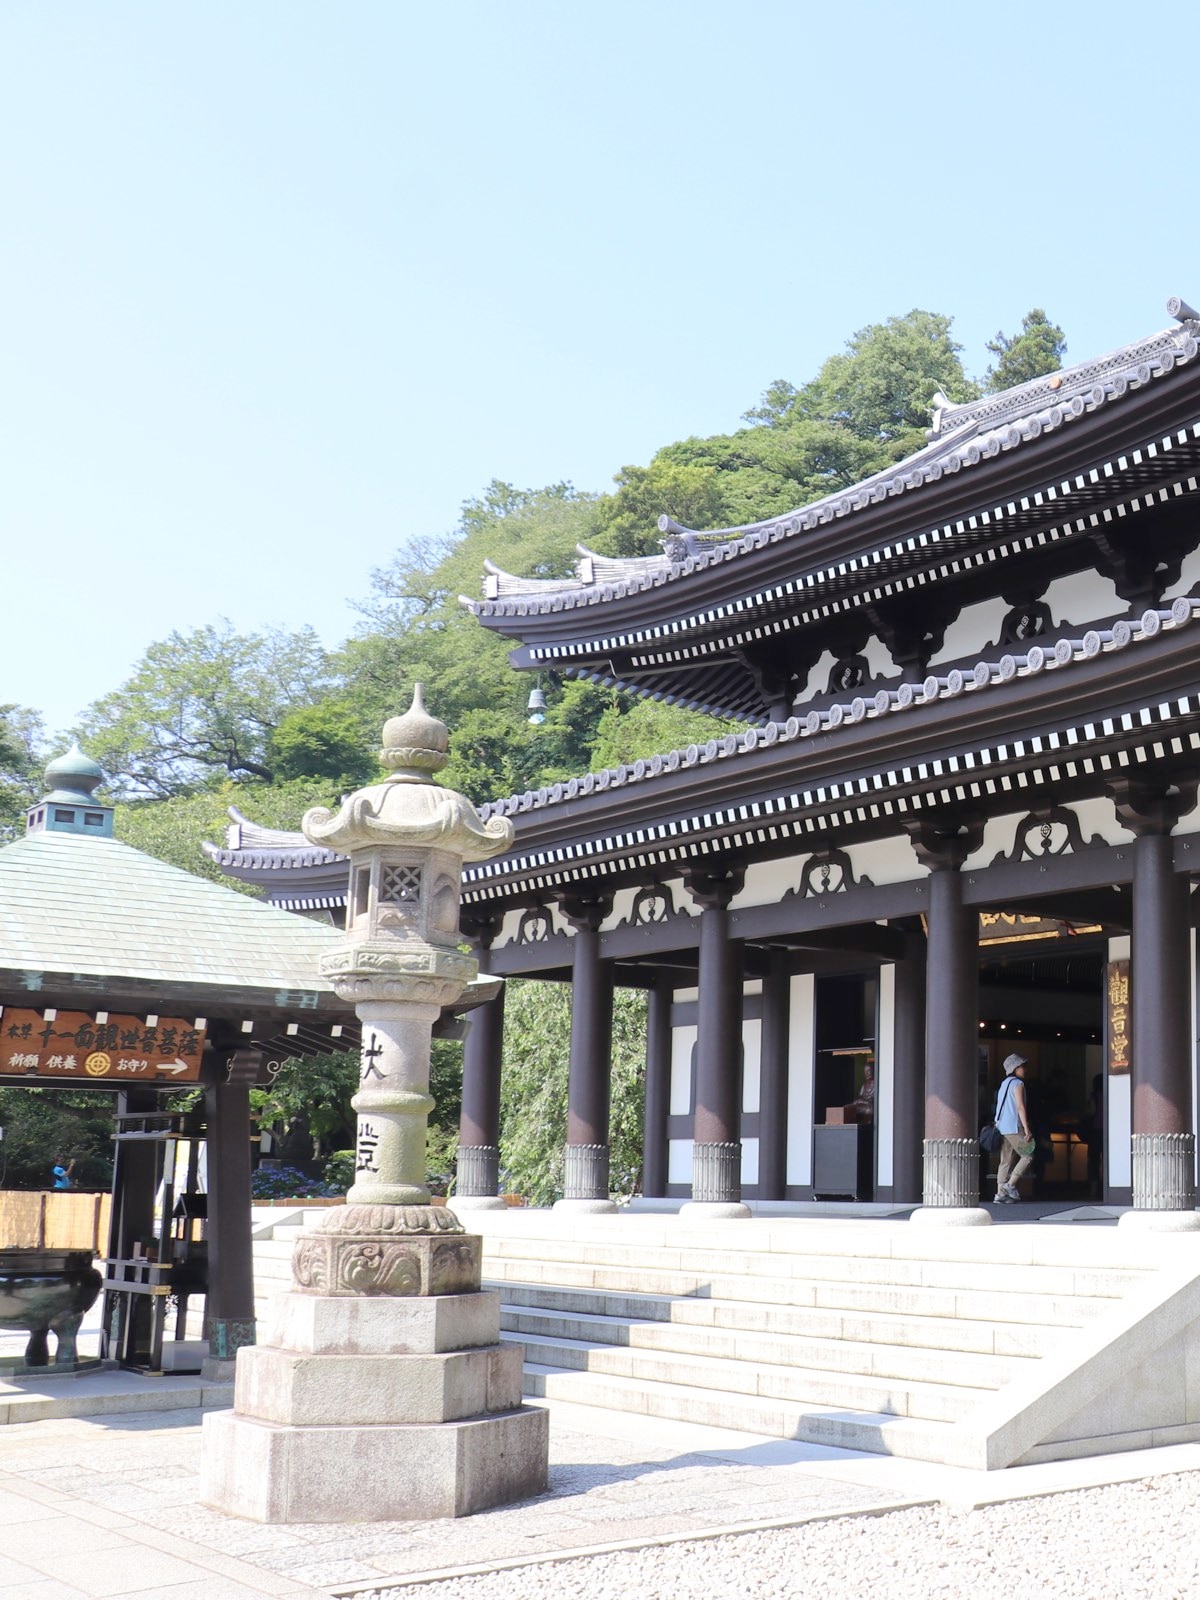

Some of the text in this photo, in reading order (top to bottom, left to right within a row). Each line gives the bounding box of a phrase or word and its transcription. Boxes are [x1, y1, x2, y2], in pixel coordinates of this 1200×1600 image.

[8, 1053, 148, 1072] 祈願 供養 お守り
